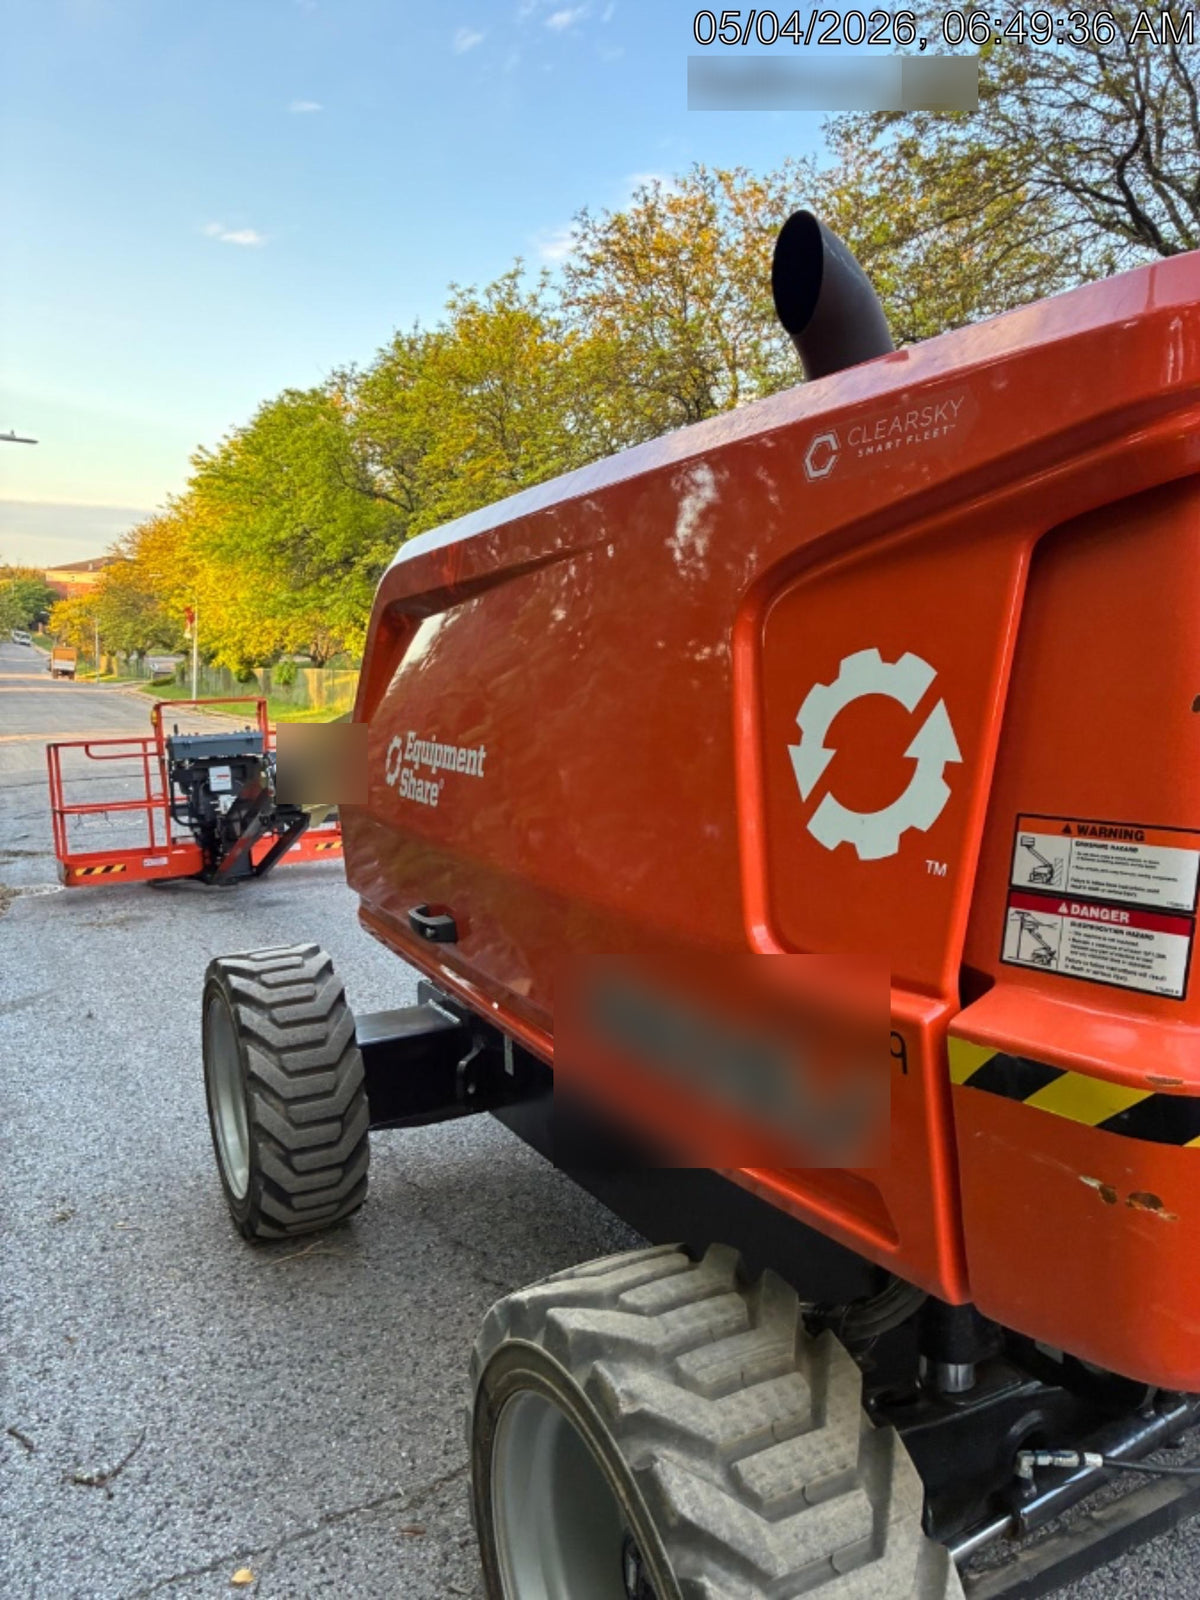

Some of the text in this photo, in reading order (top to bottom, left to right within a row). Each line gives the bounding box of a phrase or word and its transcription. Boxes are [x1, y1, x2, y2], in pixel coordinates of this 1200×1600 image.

[847, 396, 965, 447] CLEARSKY
[857, 438, 902, 458] SMART
[404, 731, 487, 777] Equipment
[399, 766, 440, 807] Share
[1076, 825, 1145, 841] WARNING
[1070, 903, 1130, 923] DANGER
